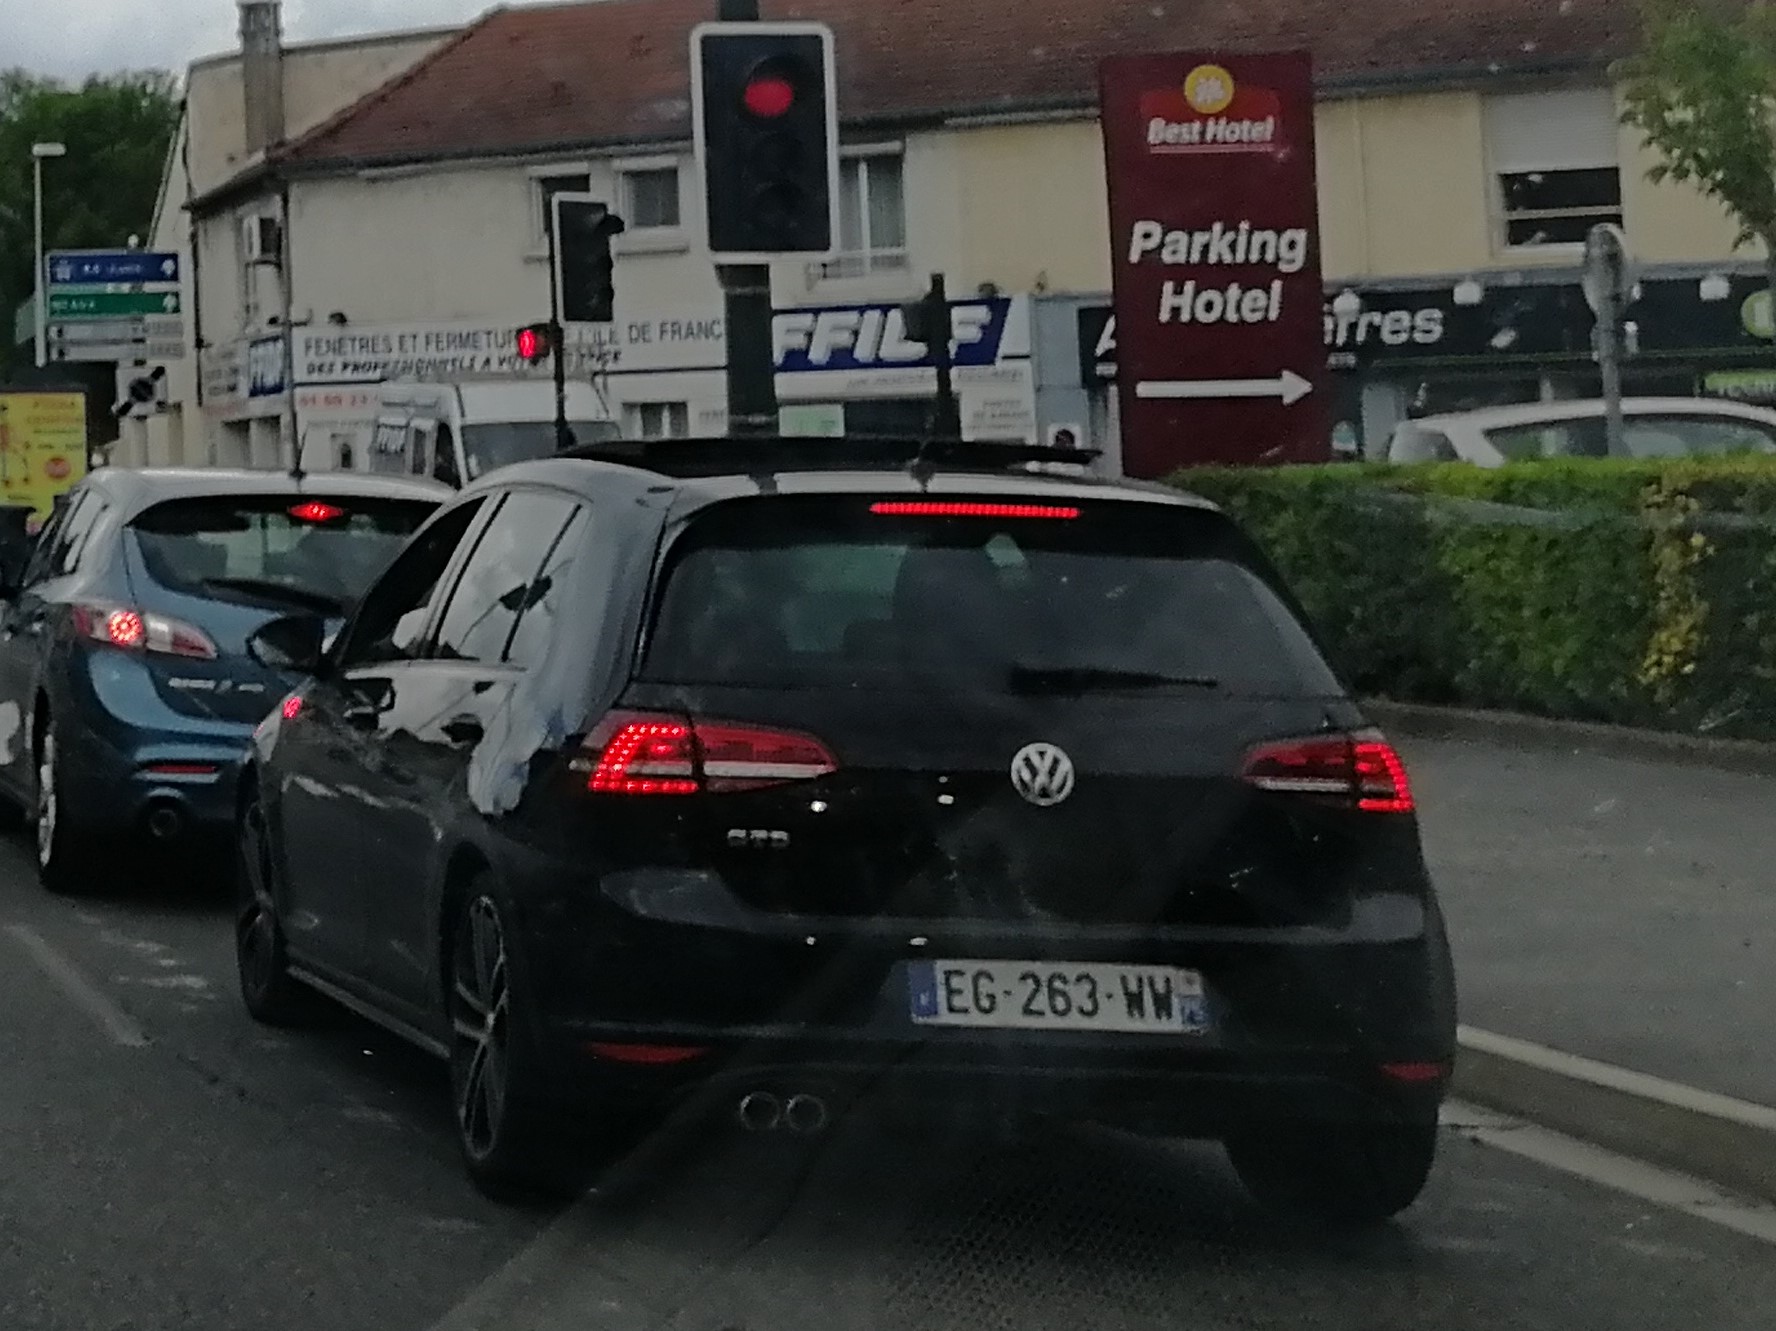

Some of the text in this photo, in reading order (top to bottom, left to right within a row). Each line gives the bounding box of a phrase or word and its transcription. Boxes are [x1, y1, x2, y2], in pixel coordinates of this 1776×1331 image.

[1147, 115, 1275, 144] Best Hotel
[1128, 220, 1308, 273] Parking
[1158, 279, 1283, 324] Hotel
[629, 319, 652, 344] DE
